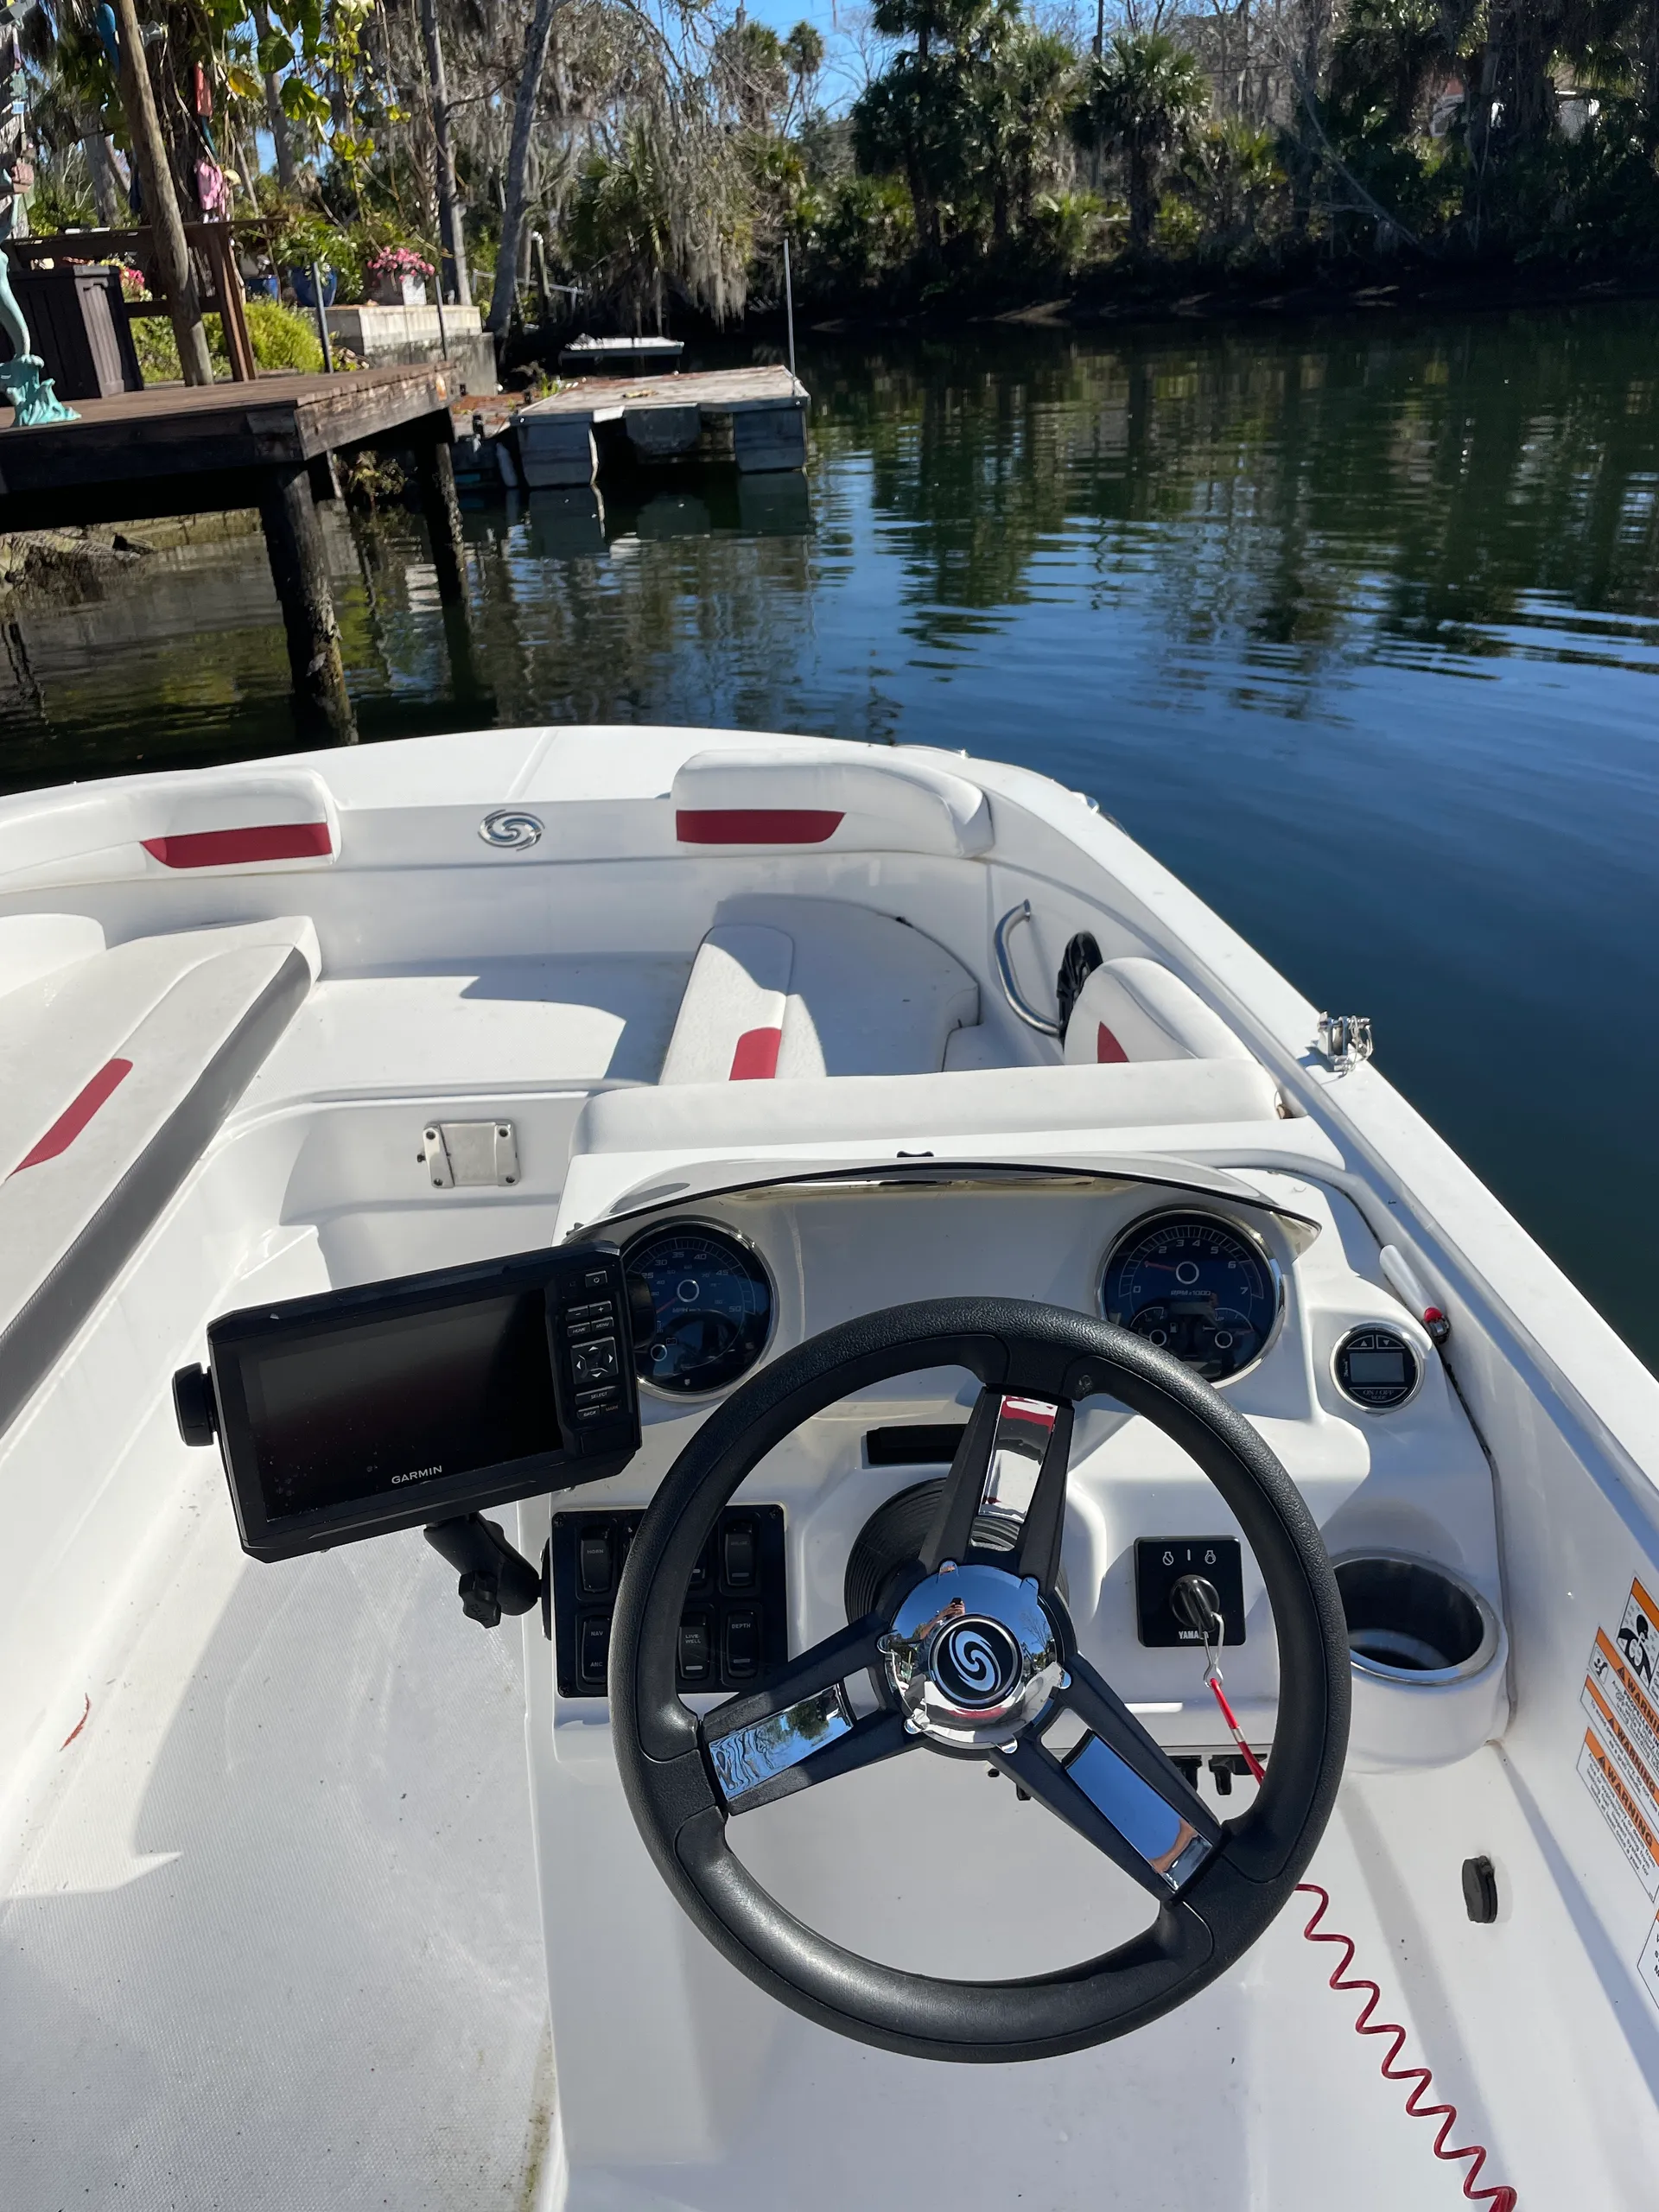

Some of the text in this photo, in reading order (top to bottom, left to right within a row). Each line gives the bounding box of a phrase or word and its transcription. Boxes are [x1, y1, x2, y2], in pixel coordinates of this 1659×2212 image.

[1211, 1246, 1219, 1255] 5
[1228, 1261, 1236, 1269] 6
[591, 1391, 607, 1400] SELECT
[391, 1465, 442, 1484] GARMIN
[1615, 1726, 1656, 1794] WARNING
[1606, 1766, 1653, 1847] WARNING
